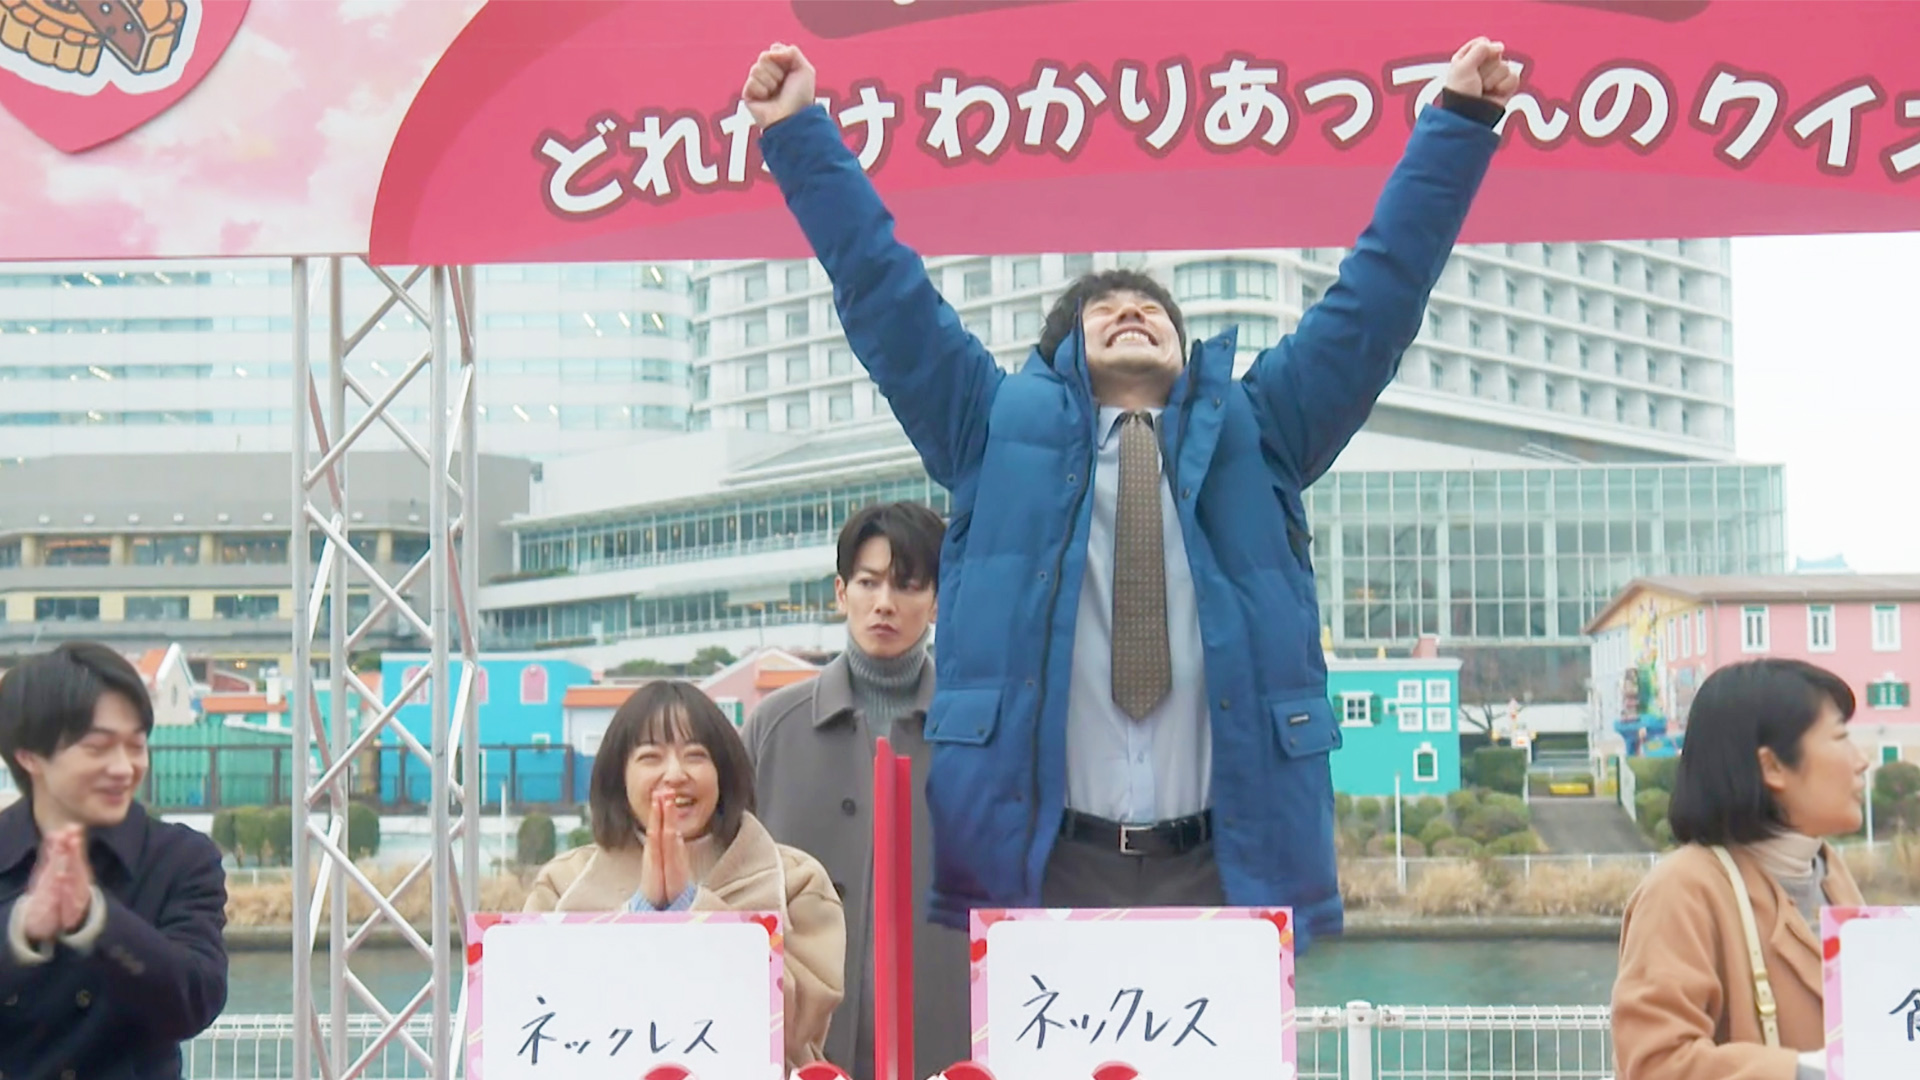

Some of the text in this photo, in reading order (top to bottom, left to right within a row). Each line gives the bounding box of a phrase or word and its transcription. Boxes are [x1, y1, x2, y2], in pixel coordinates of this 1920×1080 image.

[516, 996, 718, 1065] ネックレス
[1015, 974, 1218, 1050] ネックレス
